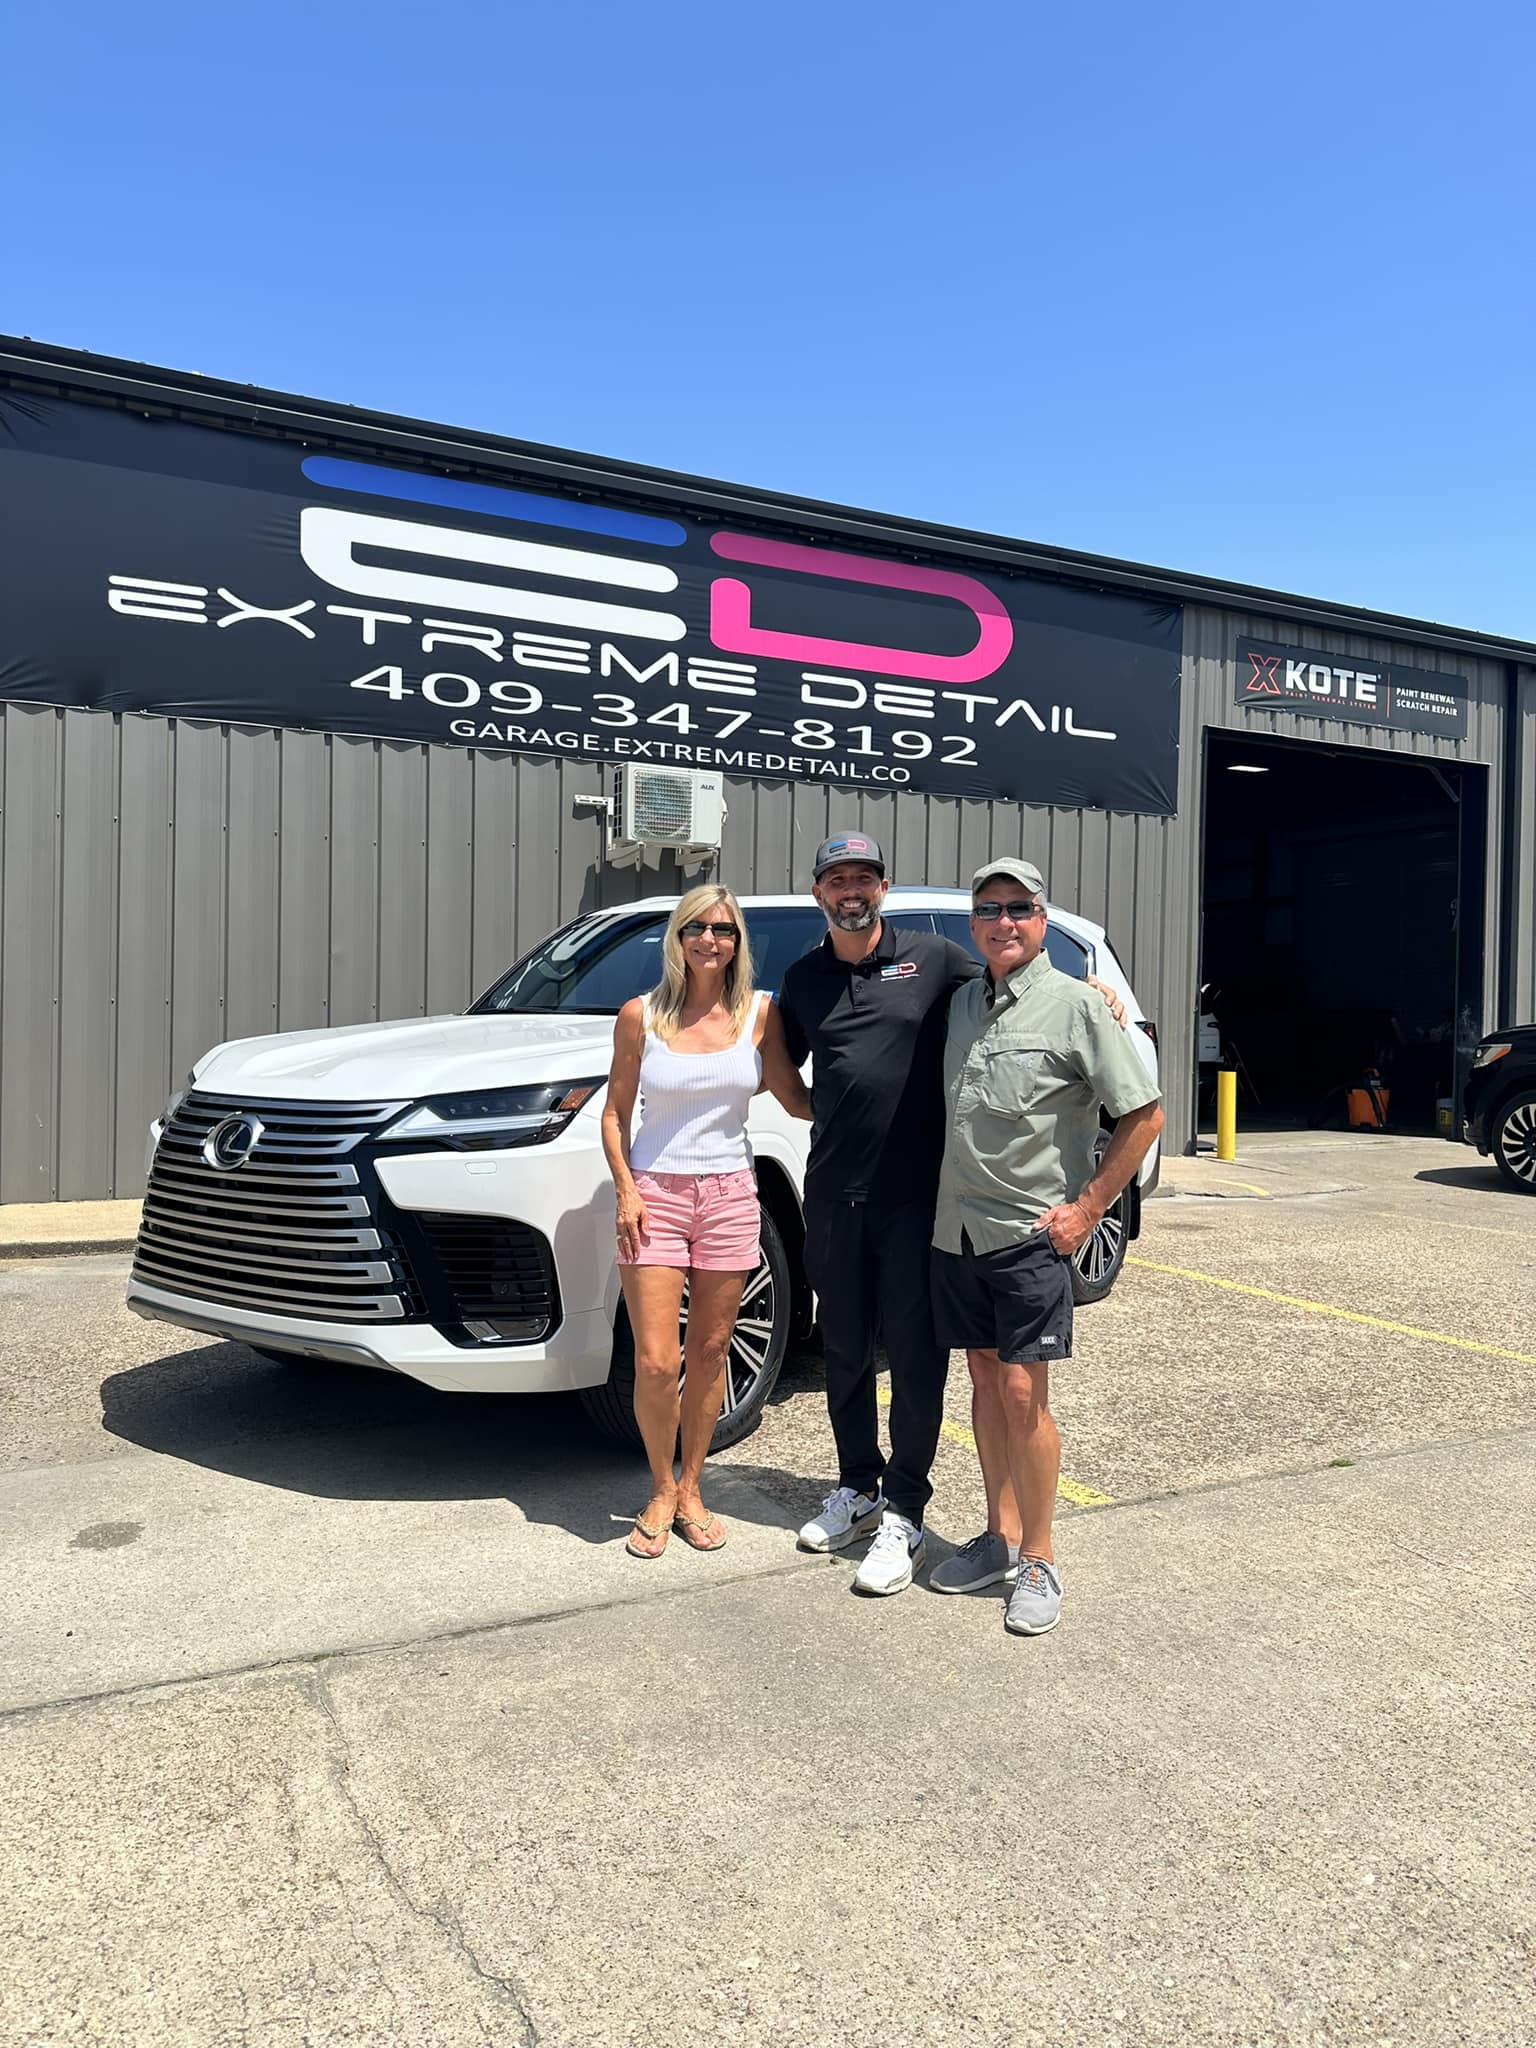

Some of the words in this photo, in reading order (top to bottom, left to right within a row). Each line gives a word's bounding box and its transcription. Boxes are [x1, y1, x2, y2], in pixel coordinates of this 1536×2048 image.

[108, 575, 758, 697] EXTREME
[801, 672, 1117, 740] DETAIL
[350, 665, 978, 766] 409-347-8192
[1396, 687, 1419, 698] PAINT
[1420, 691, 1455, 704] RENEWAL
[1396, 699, 1430, 712] SCRATCH
[1432, 705, 1458, 716] REPAIR
[449, 719, 911, 783] GARAGE.EXTREMEDETAIL.CO
